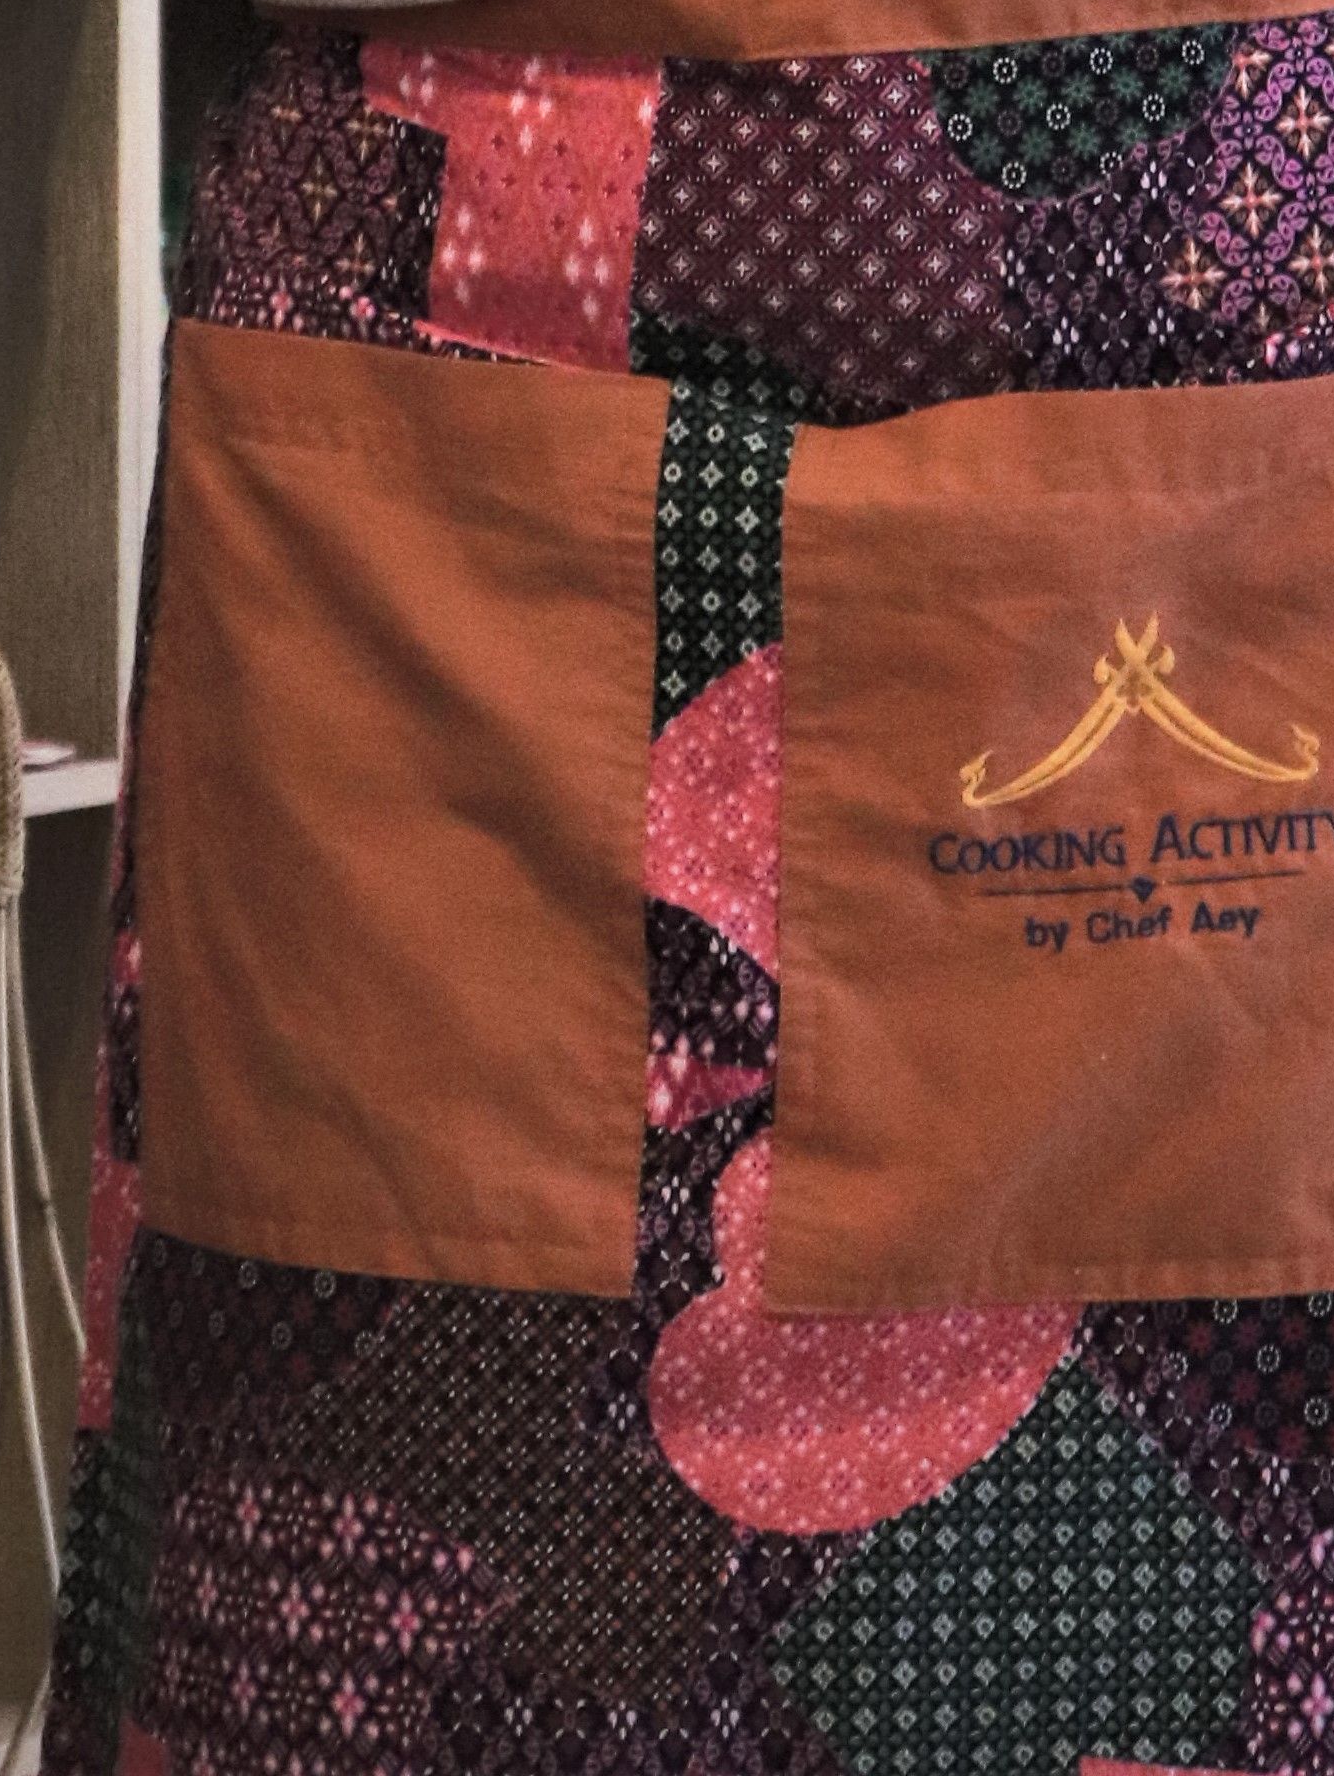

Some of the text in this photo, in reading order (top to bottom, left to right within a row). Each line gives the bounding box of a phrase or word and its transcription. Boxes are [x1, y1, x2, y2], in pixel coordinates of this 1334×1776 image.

[929, 826, 1127, 874] COOKING
[1025, 915, 1070, 953] by
[1086, 904, 1173, 944] Chef
